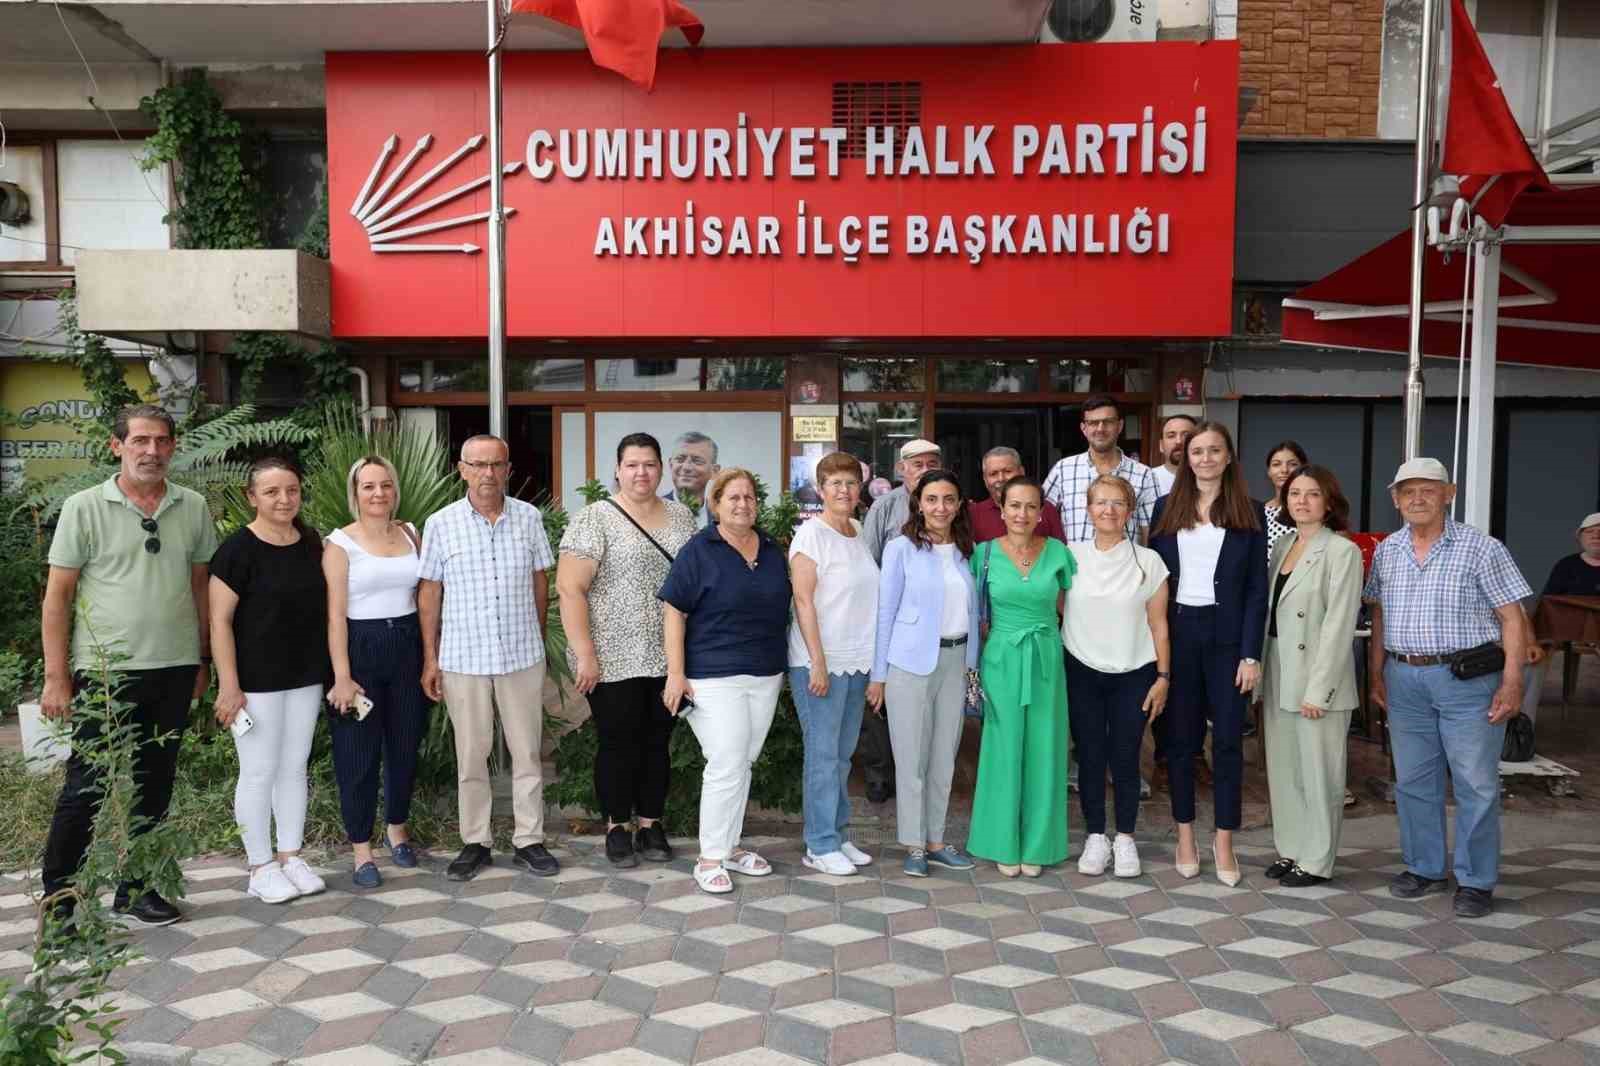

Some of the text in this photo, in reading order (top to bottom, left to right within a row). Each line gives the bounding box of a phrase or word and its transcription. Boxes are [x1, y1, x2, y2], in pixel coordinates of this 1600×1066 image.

[525, 105, 1207, 180] CUMHURİYET HALK PARTİSİ
[593, 199, 1170, 265] AKHİSAR İLÇE BAŞKANLIĞI
